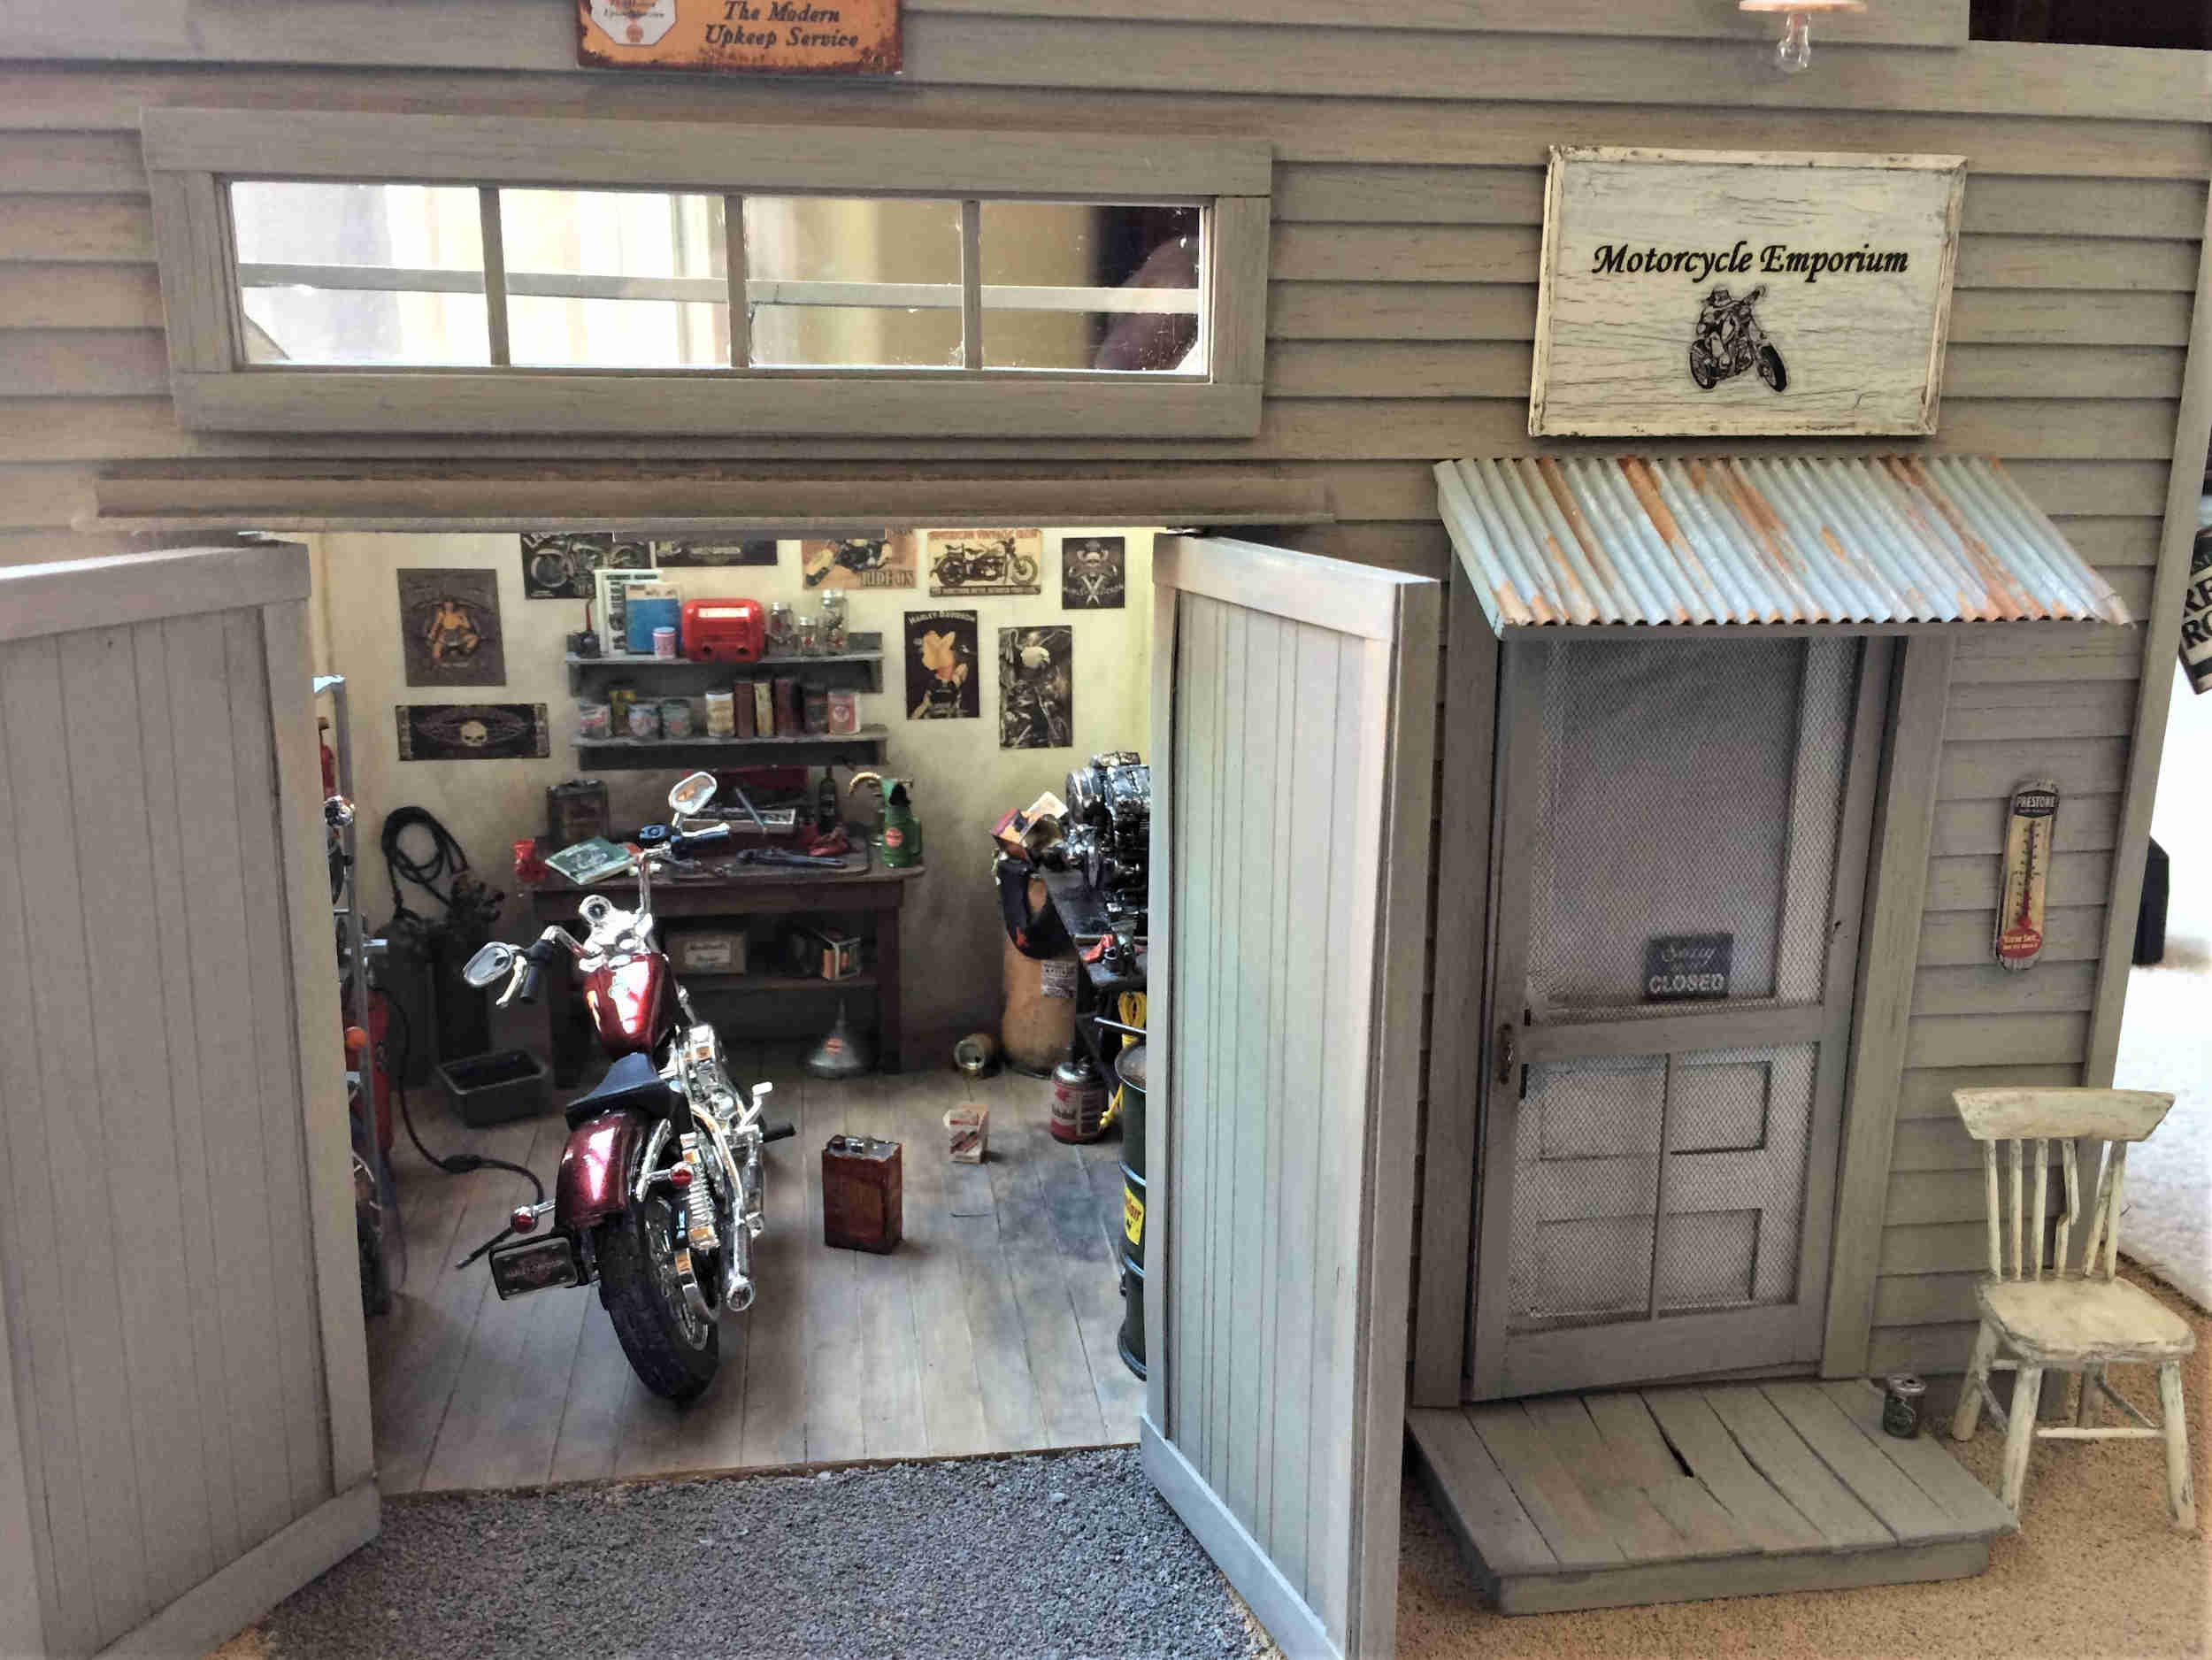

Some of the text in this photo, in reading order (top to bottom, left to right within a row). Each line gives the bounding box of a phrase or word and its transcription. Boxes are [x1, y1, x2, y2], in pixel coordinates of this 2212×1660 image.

[725, 0, 840, 22] The Modern
[704, 24, 859, 49] Upkeep Service
[1592, 241, 1909, 282] Motorcycle Emporium
[1648, 973, 1726, 993] CLOSED
